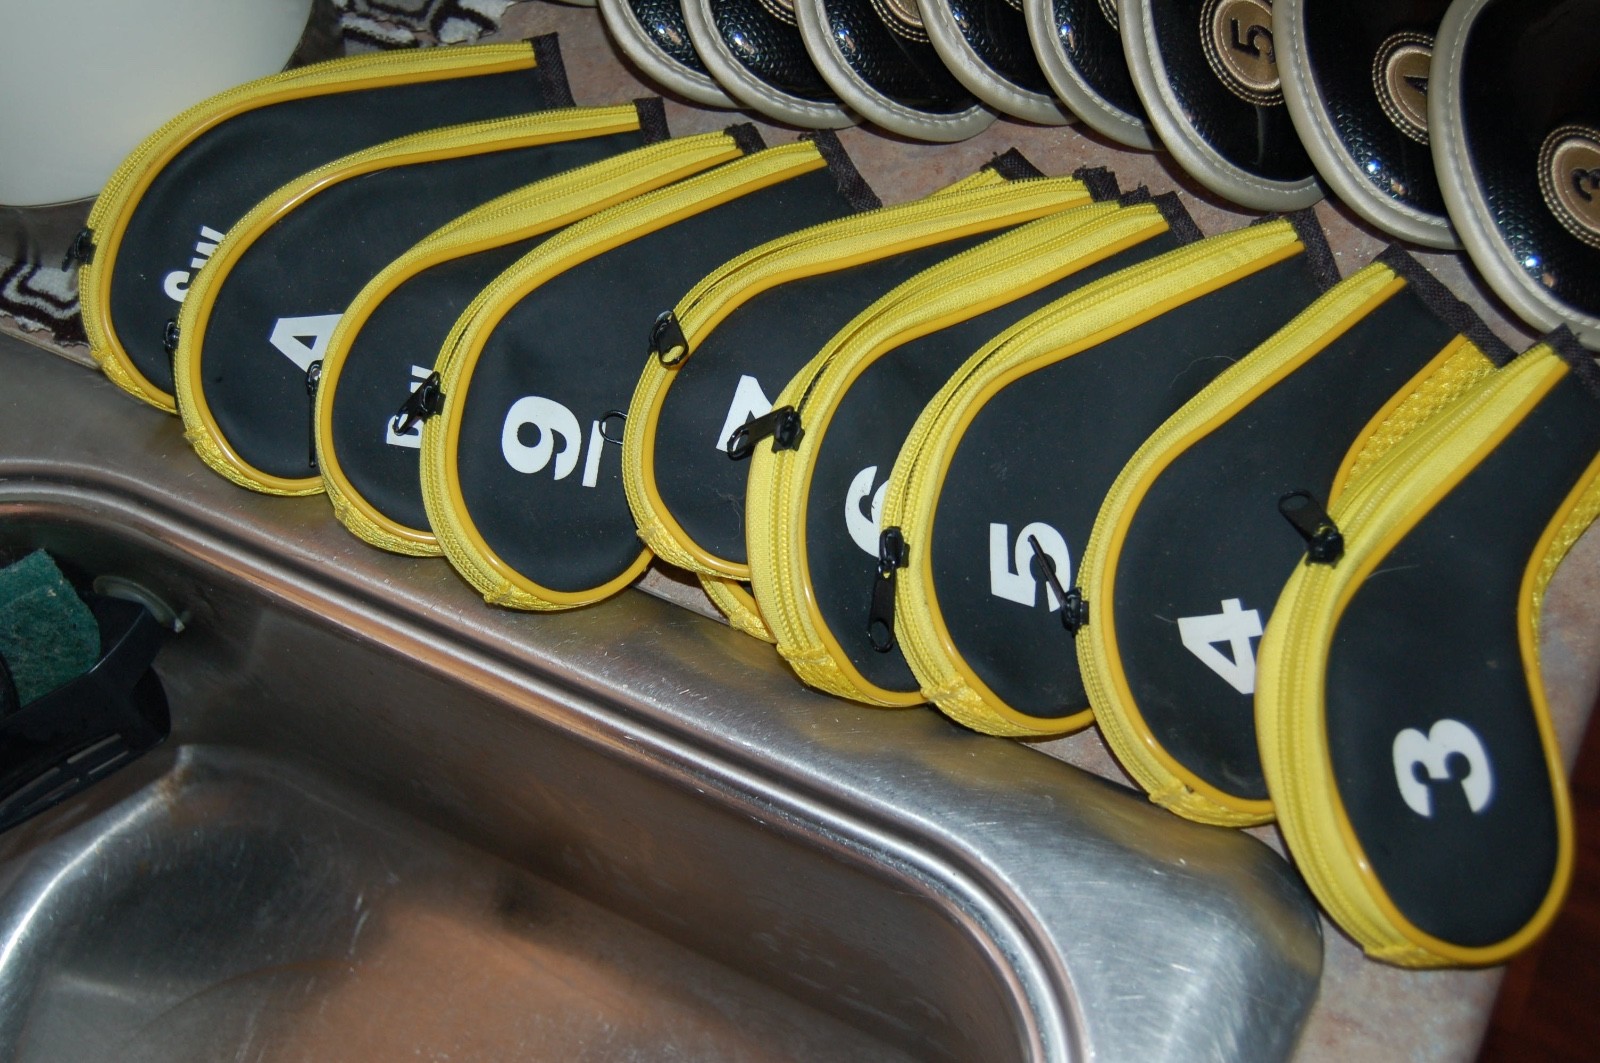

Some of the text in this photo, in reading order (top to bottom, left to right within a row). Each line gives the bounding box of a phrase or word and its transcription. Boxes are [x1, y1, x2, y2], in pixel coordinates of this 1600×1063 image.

[269, 313, 345, 373] A
[501, 395, 582, 481] 9
[989, 521, 1072, 613] 5
[1177, 597, 1267, 695] 4
[1392, 719, 1492, 818] 3
